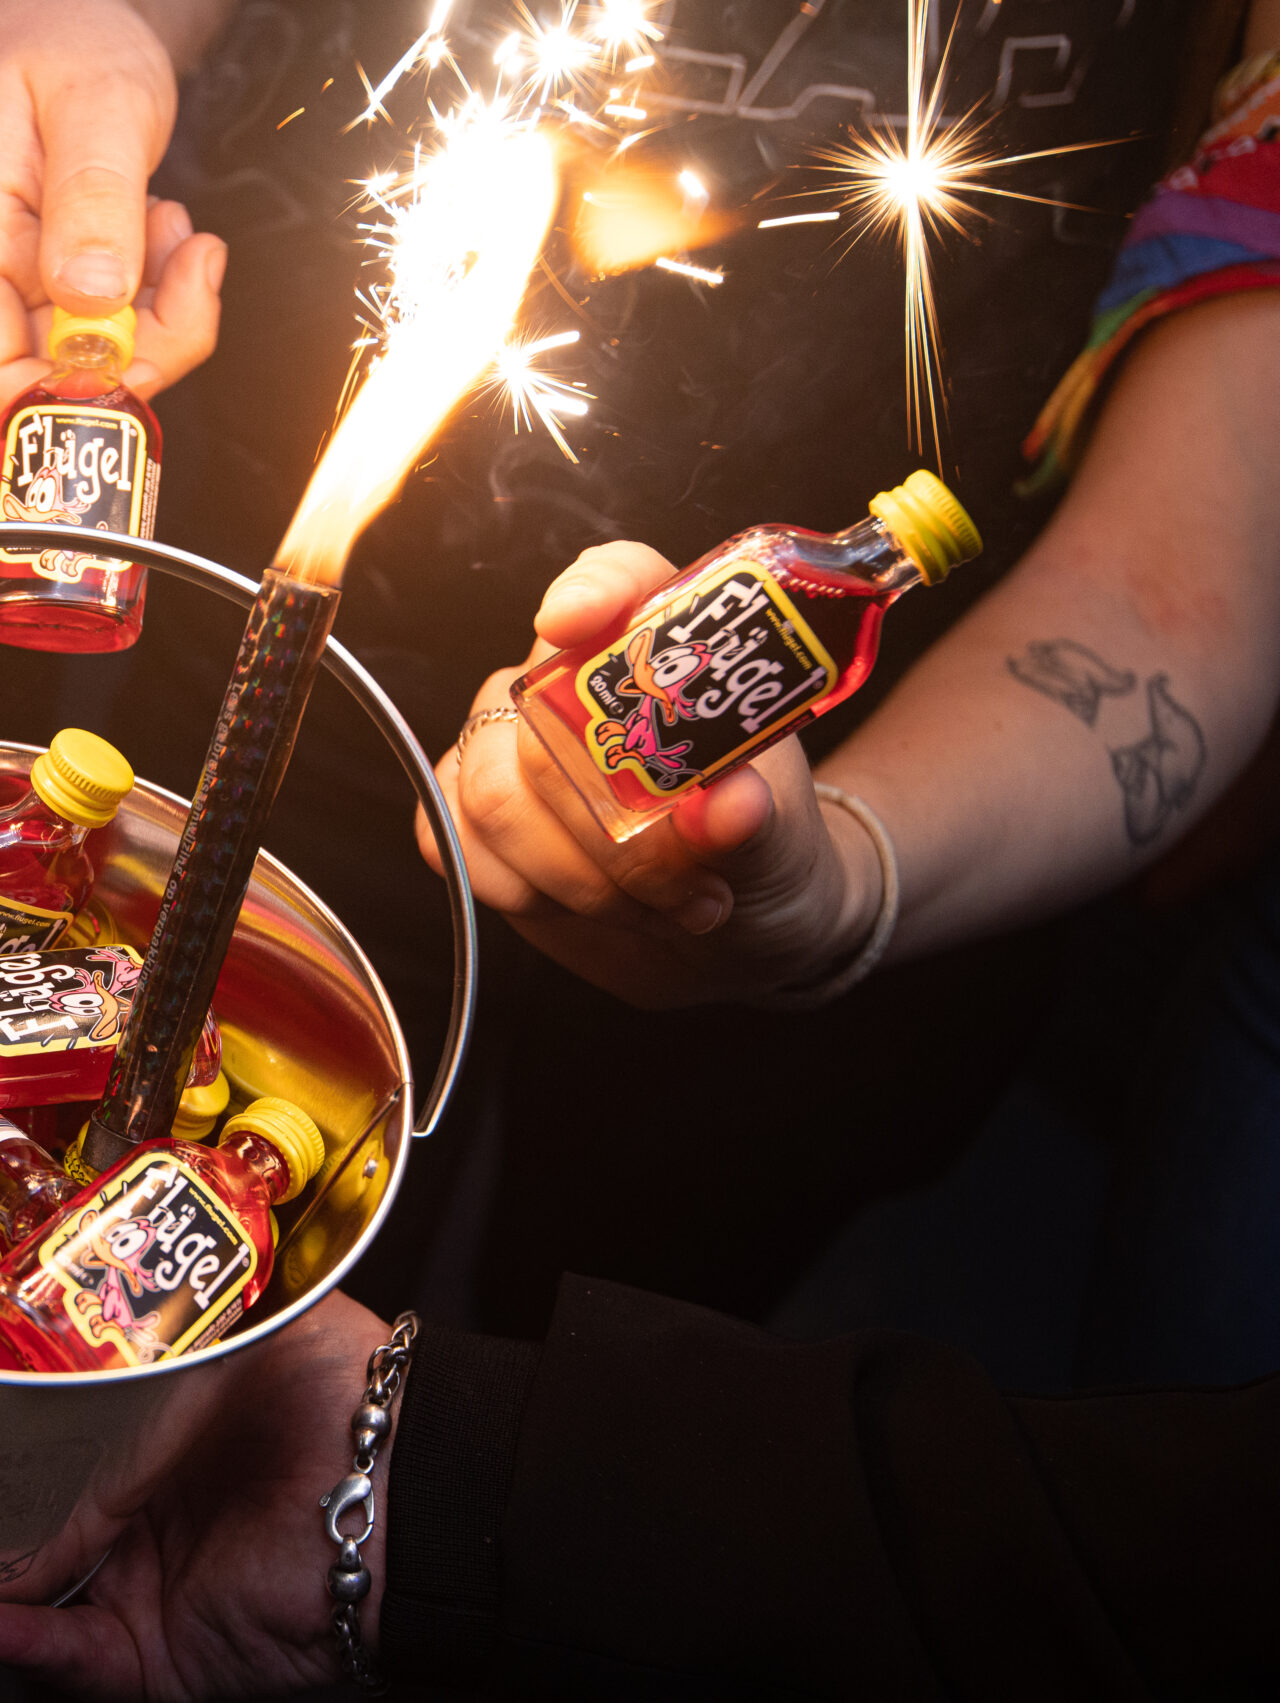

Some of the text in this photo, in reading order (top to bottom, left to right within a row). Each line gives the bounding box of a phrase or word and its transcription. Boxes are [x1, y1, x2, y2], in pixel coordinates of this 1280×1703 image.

[55, 416, 118, 430] www.flugel.com
[18, 412, 132, 504] Flügel
[668, 580, 827, 734] Flügel
[764, 607, 814, 671] www.flugel.com
[167, 880, 178, 900] op
[114, 1163, 251, 1310] Flügel
[188, 1187, 238, 1246] www.flugel.com
